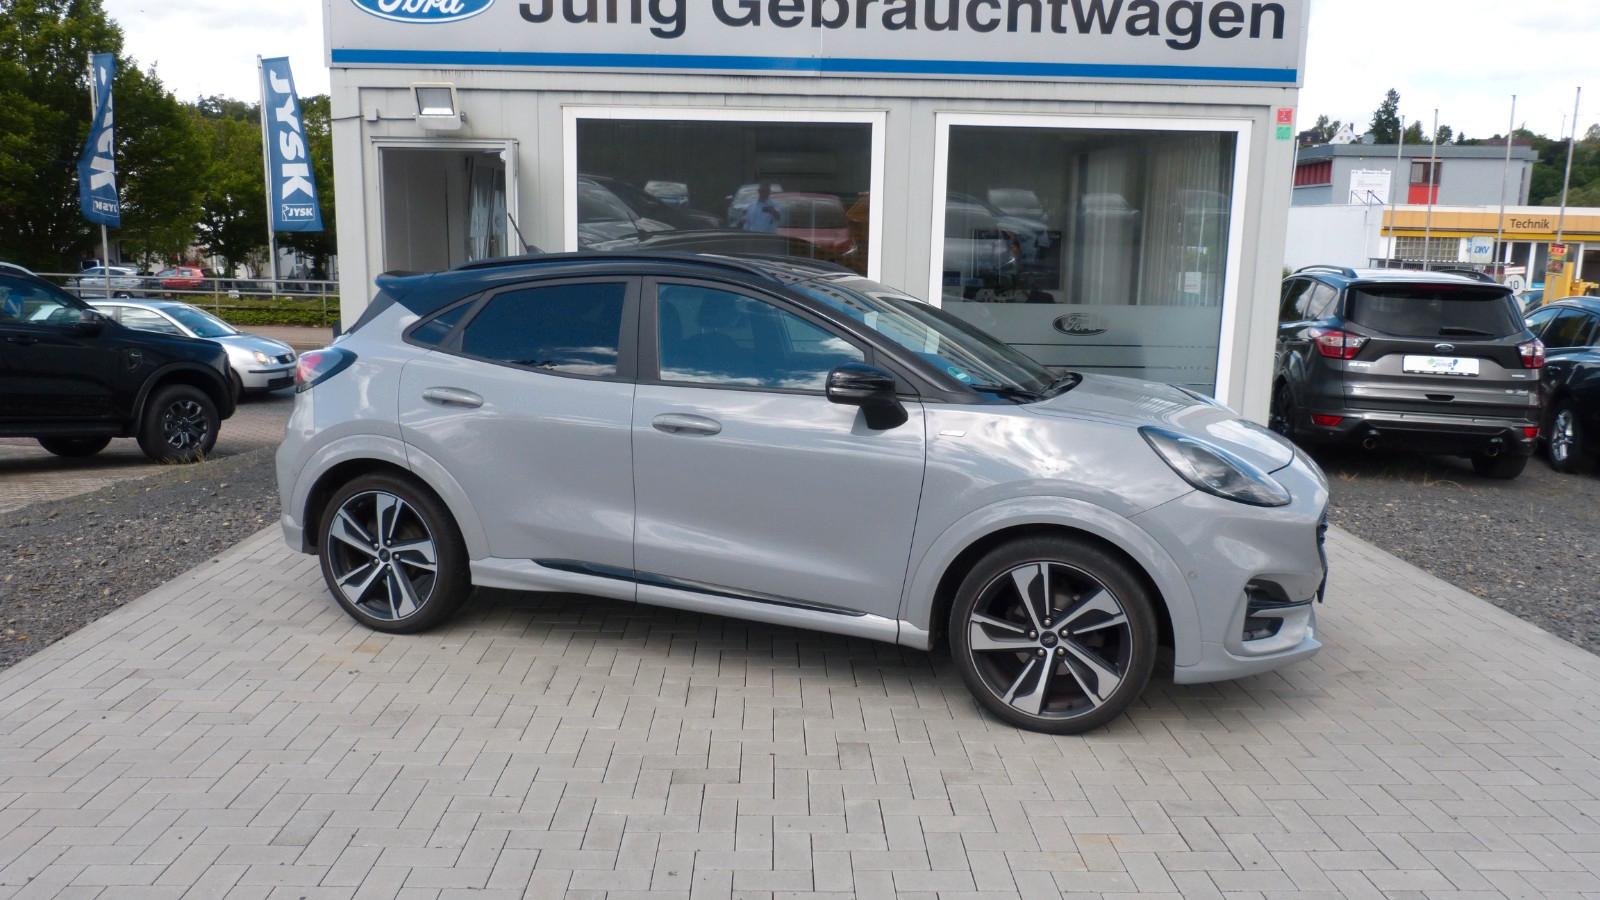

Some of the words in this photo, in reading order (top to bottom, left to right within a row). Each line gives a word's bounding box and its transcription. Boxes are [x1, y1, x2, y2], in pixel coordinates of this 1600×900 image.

[711, 0, 1285, 51] Gebrauchtwagen
[269, 70, 314, 200] JYSK
[288, 207, 313, 217] JYSK
[1510, 218, 1550, 229] Technik
[1474, 246, 1490, 254] DKV
[1509, 280, 1520, 290] 10
